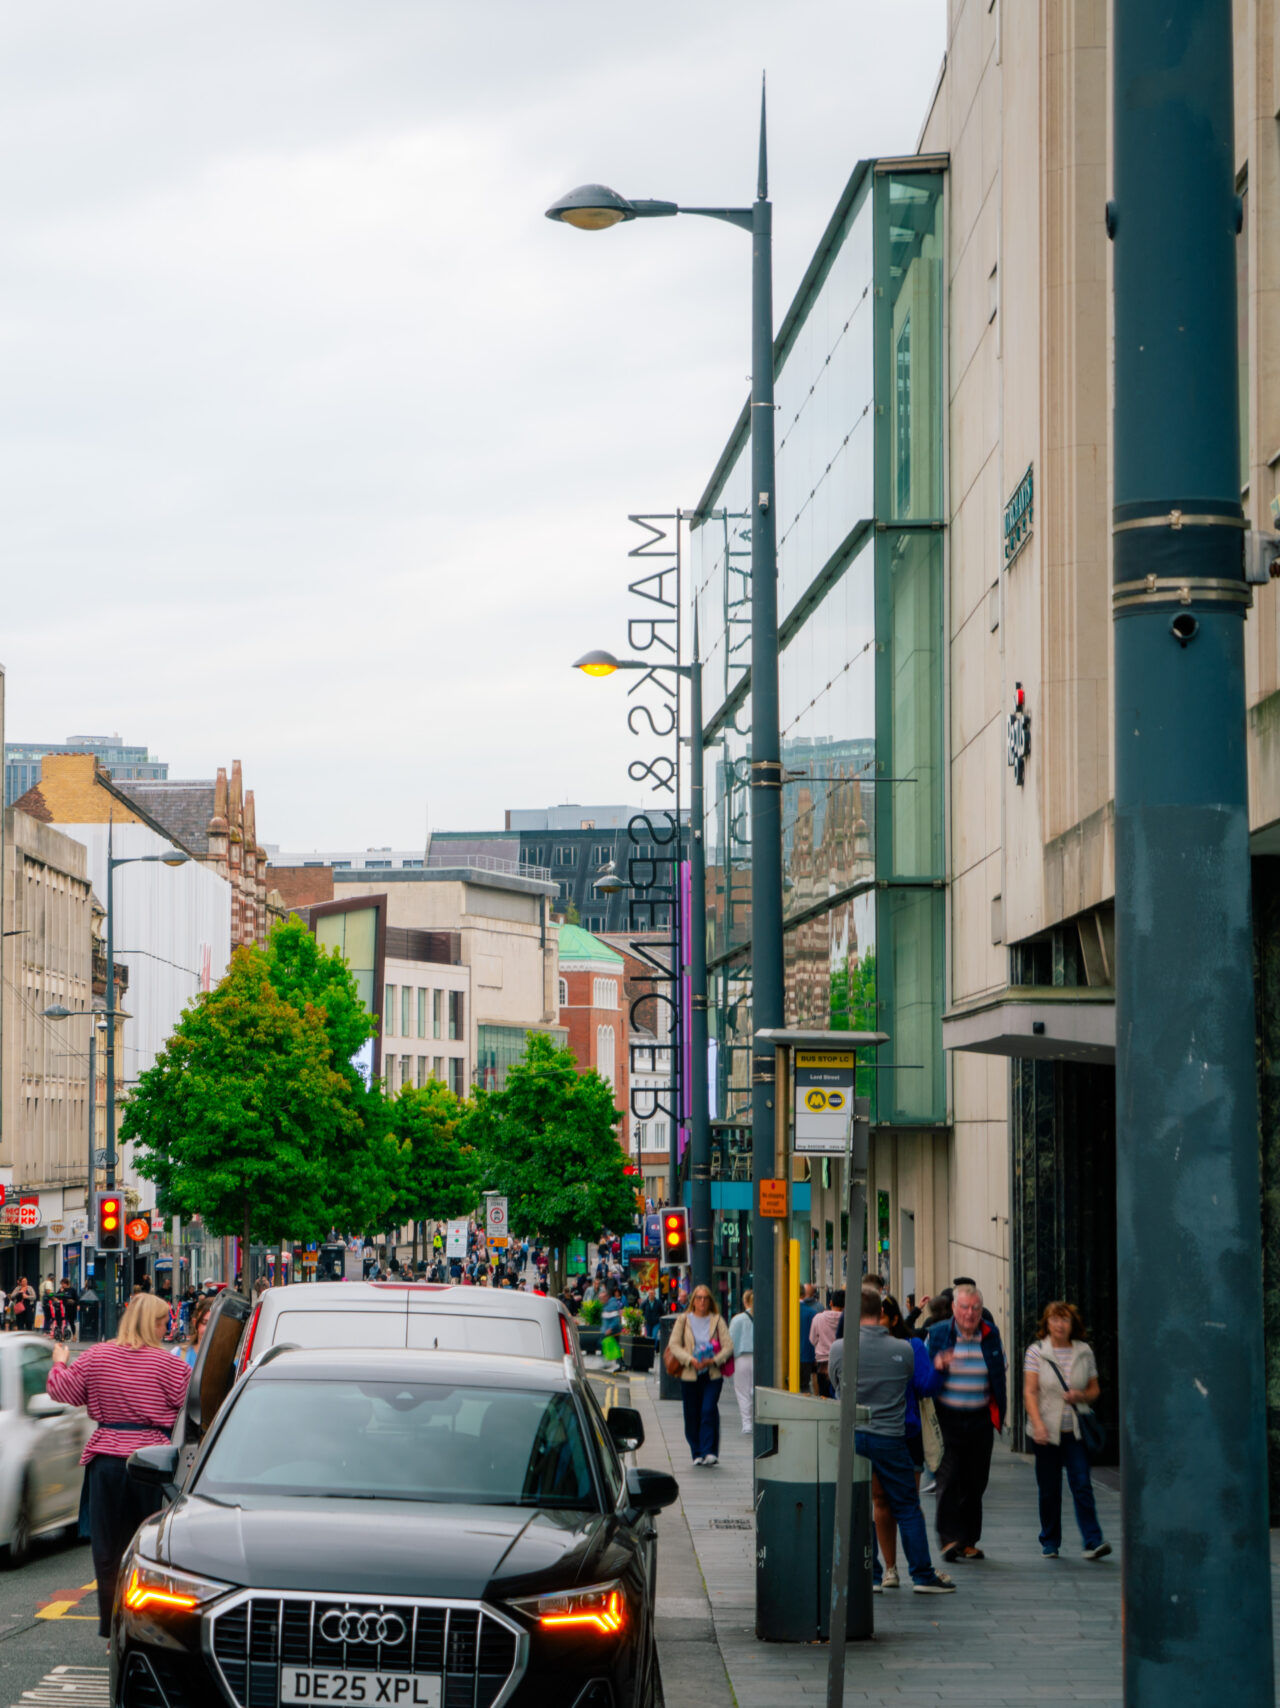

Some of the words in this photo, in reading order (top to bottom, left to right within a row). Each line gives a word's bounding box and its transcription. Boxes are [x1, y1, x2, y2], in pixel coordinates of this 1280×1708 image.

[819, 1055, 838, 1063] STOP
[294, 1671, 367, 1702] DE25
[375, 1675, 429, 1705] XPL
